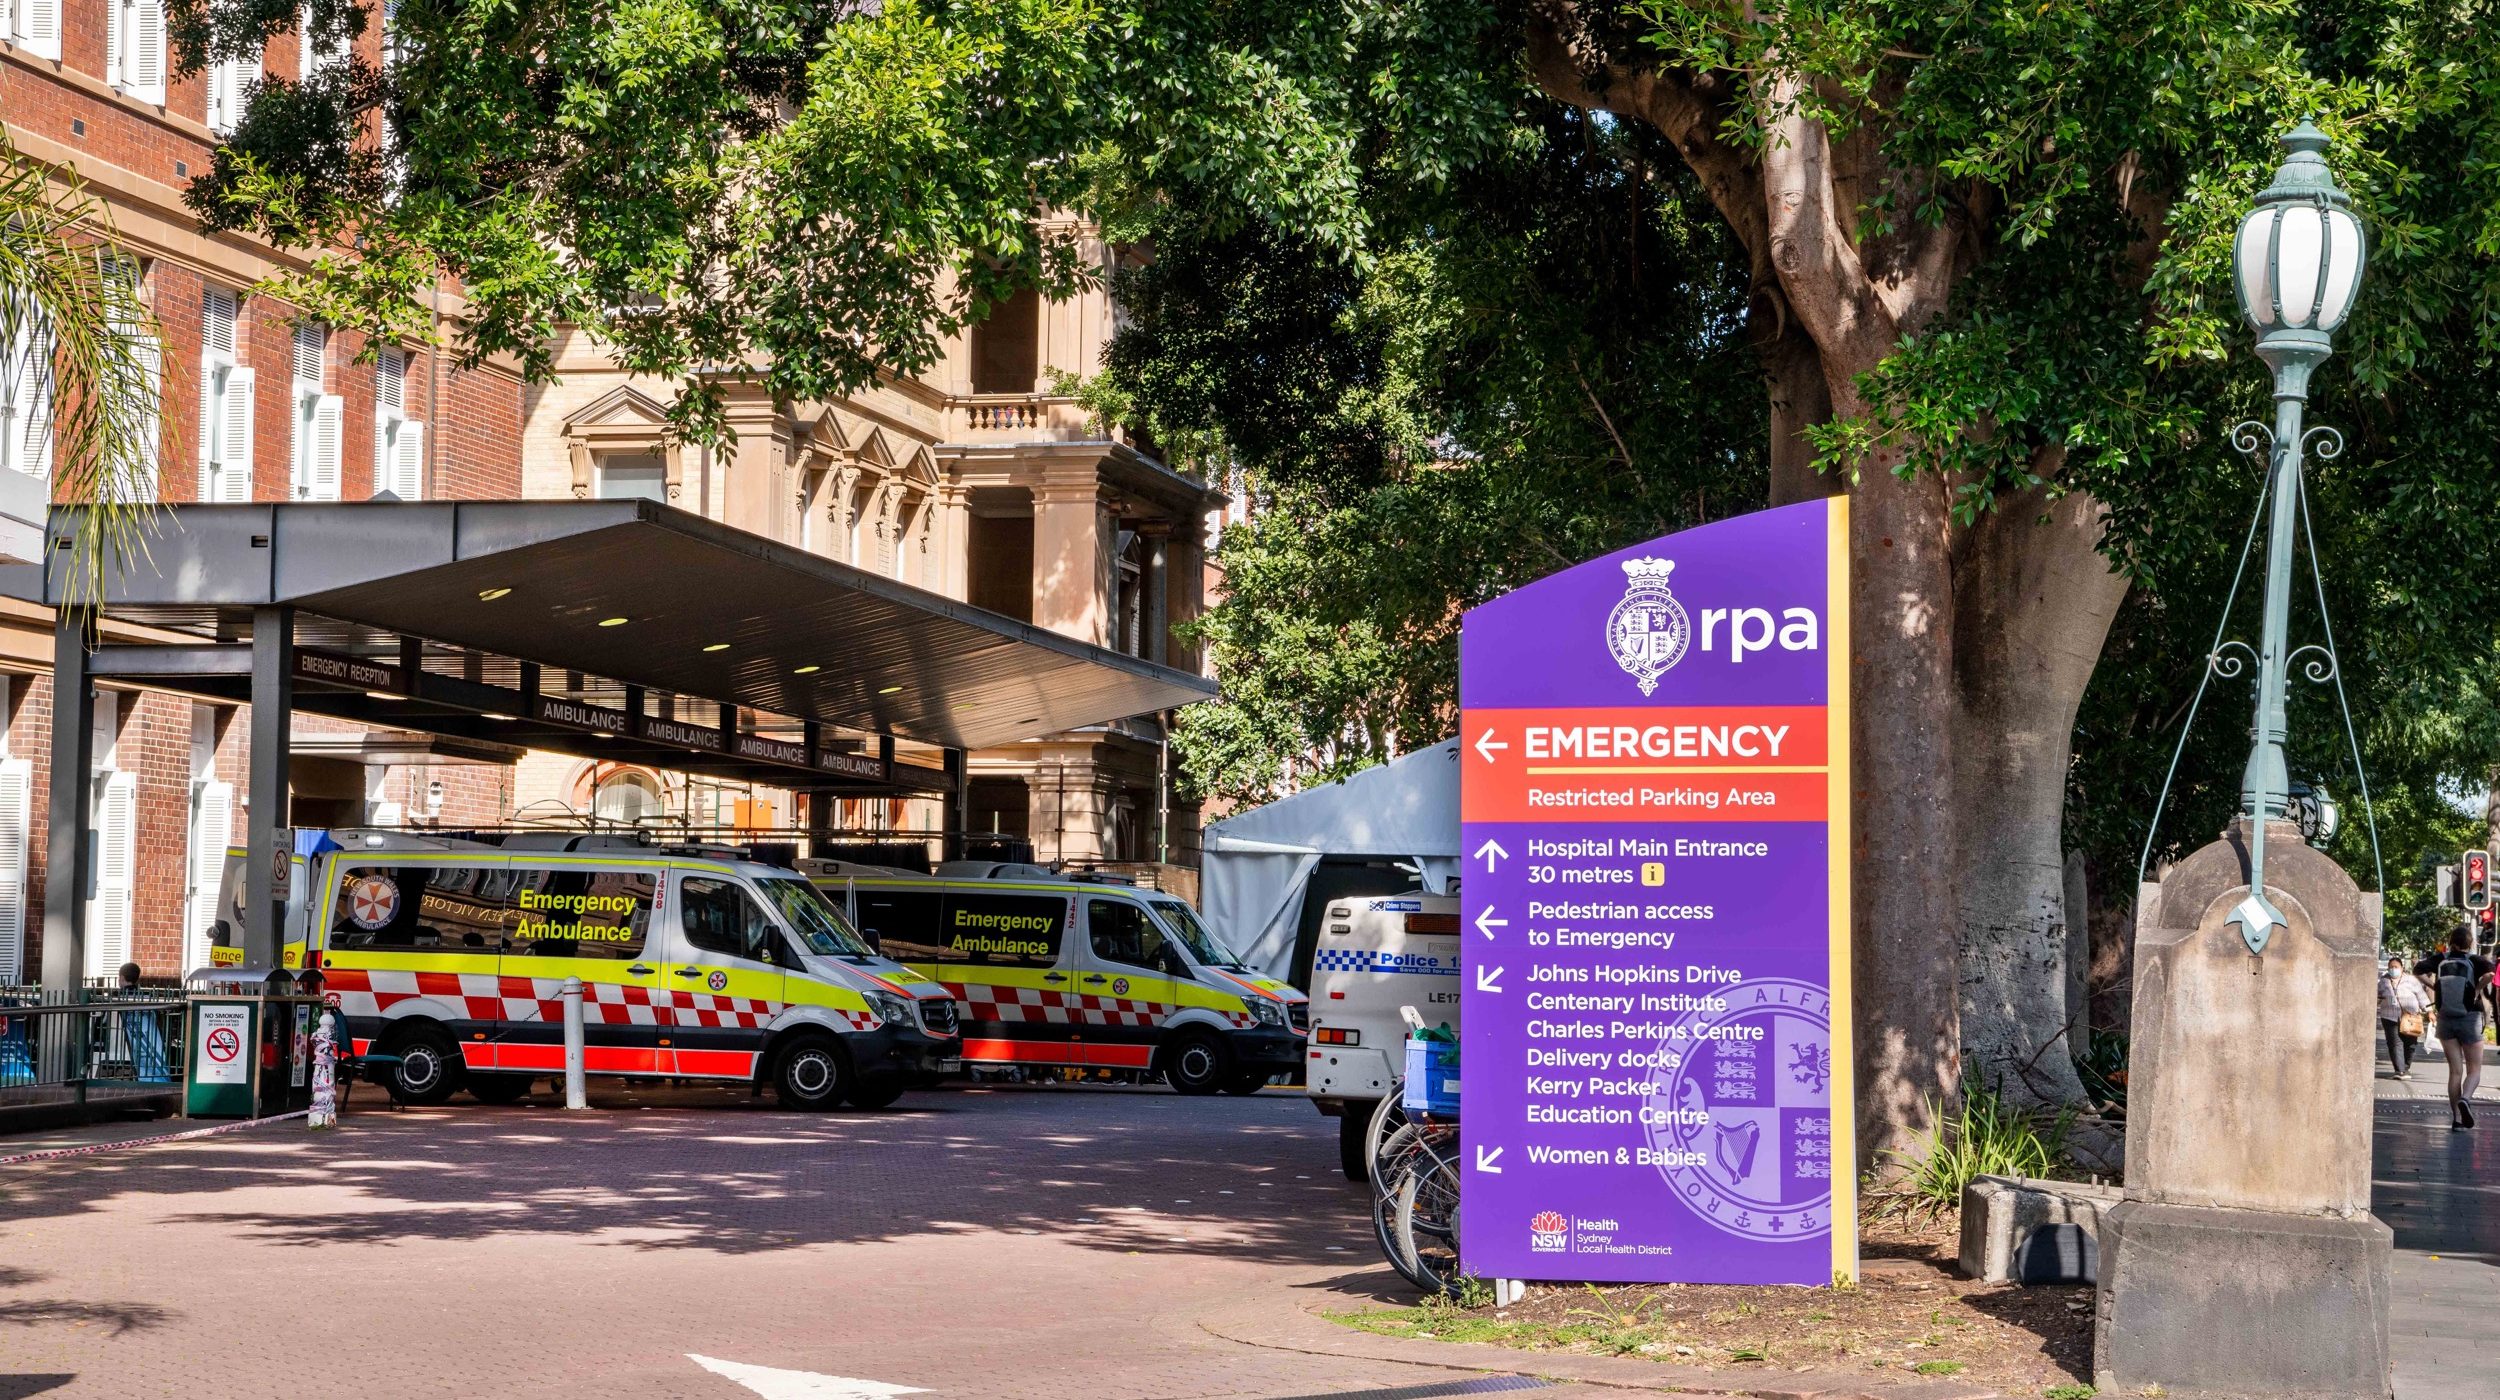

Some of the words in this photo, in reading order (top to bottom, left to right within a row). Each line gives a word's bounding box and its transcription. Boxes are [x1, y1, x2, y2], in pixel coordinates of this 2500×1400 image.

[1617, 595, 1646, 617] PRINCE
[1652, 595, 1682, 619] ALFRED
[1666, 623, 1686, 664] HOSPITAL
[1701, 607, 1818, 663] rpa
[302, 655, 348, 678] EMERGENCY
[350, 664, 391, 686] RECEPTION
[544, 702, 625, 731] AMBULANCE
[647, 722, 720, 749] AMBULANCE
[1525, 725, 1790, 758] EMERGENCY
[740, 739, 805, 763] AMBULANCE
[822, 754, 881, 776] AMBULANCE
[1528, 787, 1634, 807] Restricted
[1640, 787, 1719, 809] Parking
[1725, 787, 1776, 806] Area
[1528, 838, 1613, 860] Hospital
[1620, 838, 1668, 857] Main
[1675, 839, 1768, 857] Entrance
[1528, 865, 1556, 883] 30
[1562, 866, 1634, 883] metres
[350, 882, 363, 897] NEW
[362, 874, 385, 886] SOUTH
[385, 877, 400, 898] WALES
[655, 869, 666, 909] 1458
[520, 889, 637, 916] Emergency
[1068, 896, 1077, 928] 1442
[1529, 901, 1639, 919] Pedestrian
[1644, 905, 1714, 920] access
[353, 917, 392, 930] AMBULANCE
[515, 919, 632, 942] Ambulance
[955, 909, 1053, 933] Emergency
[951, 934, 1049, 955] Ambulance
[1528, 929, 1550, 946] to
[1556, 928, 1675, 950] Emergency
[1381, 952, 1439, 967] Police
[1527, 964, 1589, 982] Johns
[1595, 964, 1680, 986] Hopkins
[1686, 965, 1742, 984] Drive
[1527, 992, 1634, 1014] Centenary
[1641, 993, 1727, 1012] Institute
[1527, 1020, 1605, 1039] Charles
[1611, 1021, 1687, 1040] Perkins
[1693, 1021, 1764, 1041] Centre
[1527, 1048, 1612, 1070] Delivery
[1618, 1049, 1681, 1068] docks
[1527, 1076, 1583, 1098] Kerry
[1589, 1077, 1661, 1096] Packer
[1527, 1104, 1632, 1124] Education
[1638, 1106, 1710, 1125] Centre
[1527, 1145, 1609, 1164] Women
[1615, 1147, 1630, 1165] &
[1636, 1147, 1707, 1167] Babies
[1577, 1218, 1619, 1231] Health
[1531, 1234, 1567, 1247] NSW
[1577, 1233, 1612, 1244] Sydney
[1577, 1244, 1603, 1253] Local
[1605, 1244, 1636, 1254] Health
[1638, 1245, 1672, 1255] District
